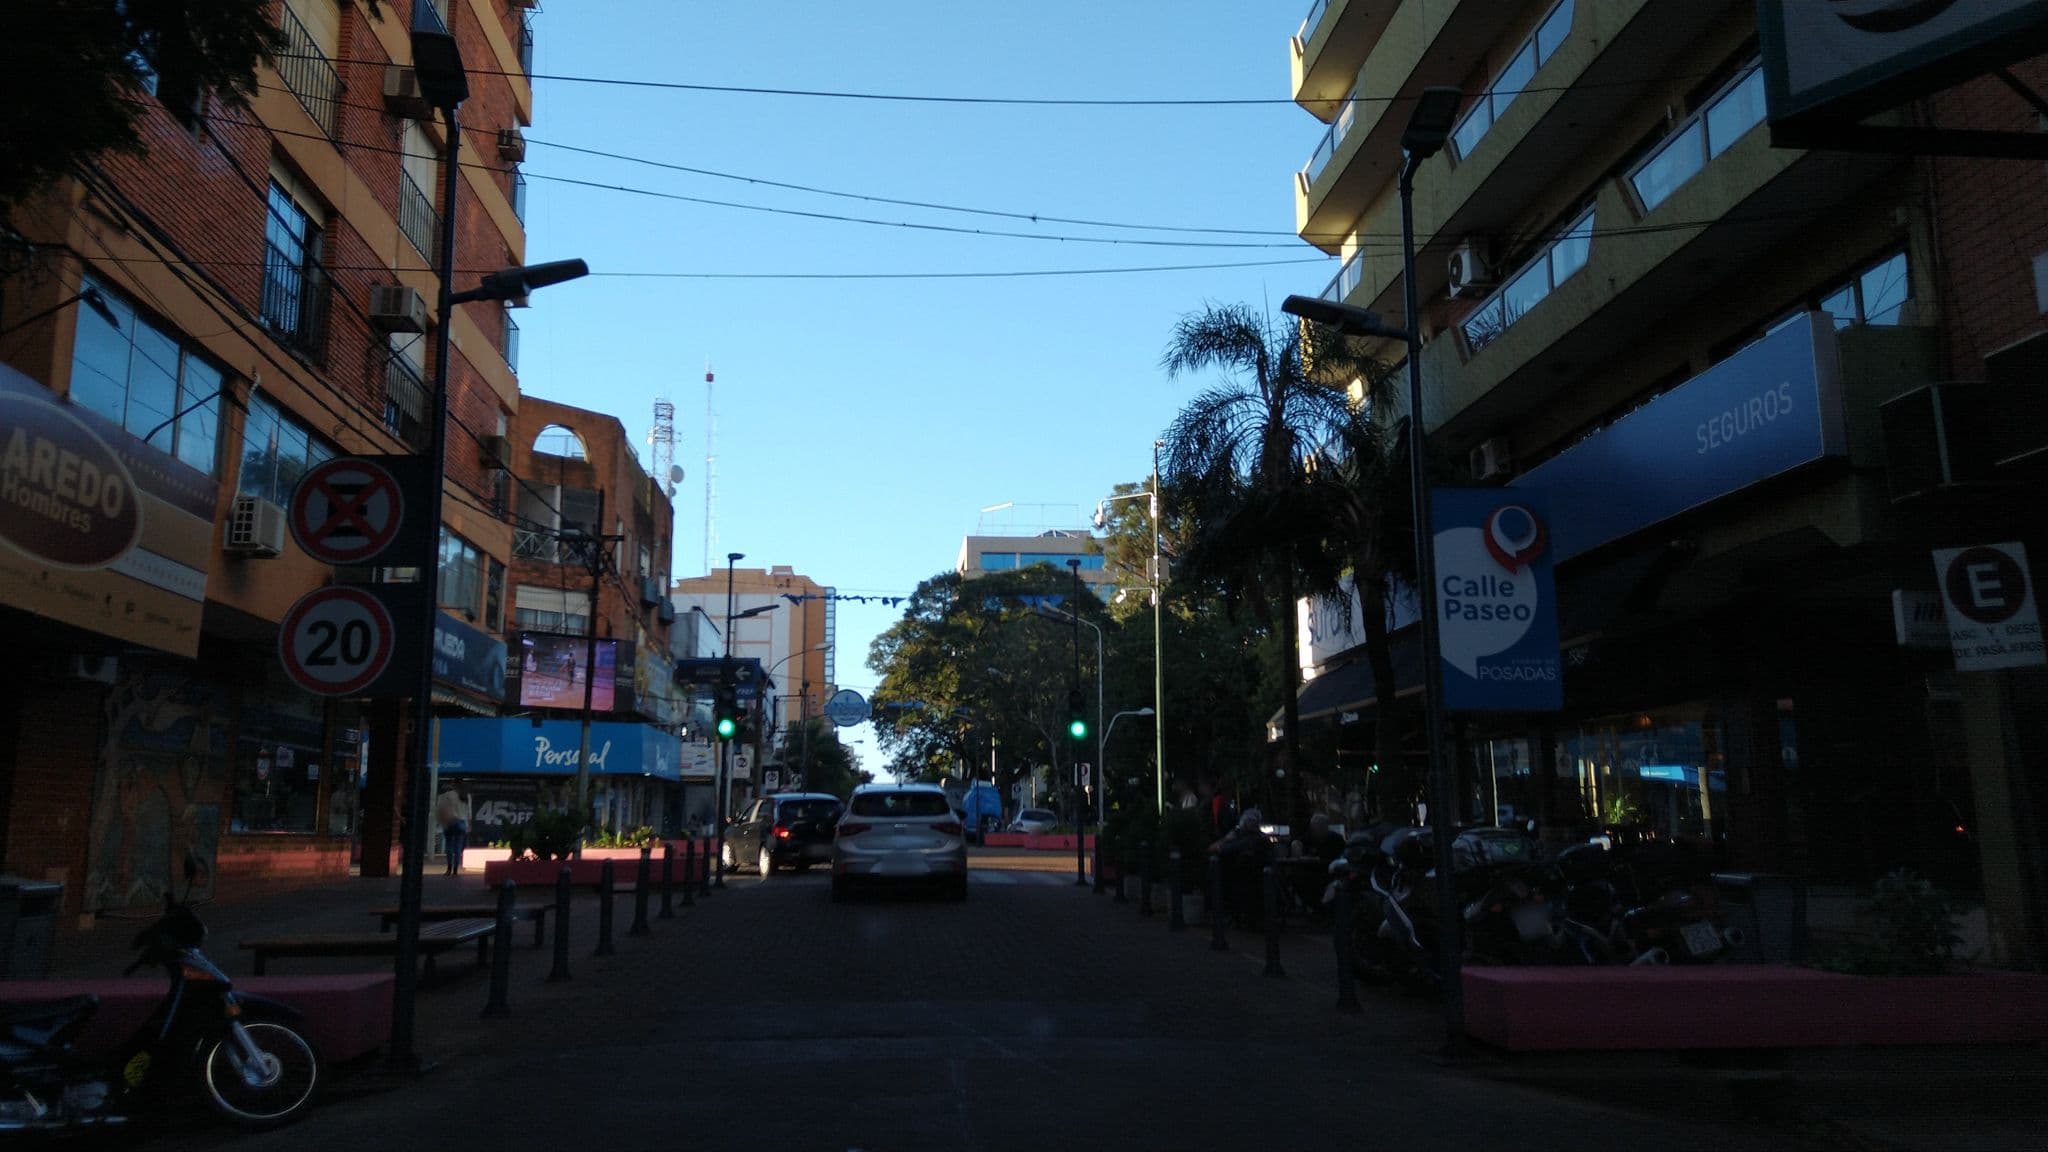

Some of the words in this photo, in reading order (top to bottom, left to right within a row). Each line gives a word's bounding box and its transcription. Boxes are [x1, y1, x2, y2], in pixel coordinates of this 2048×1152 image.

[1696, 381, 1792, 454] SEGUROS
[2, 475, 92, 533] Hombres
[1443, 575, 1515, 597] Calle
[1966, 561, 2008, 608] E
[1445, 599, 1531, 621] Paseo
[304, 620, 371, 666] 20
[1479, 665, 1557, 681] POSADAS
[535, 736, 612, 771] Persoal
